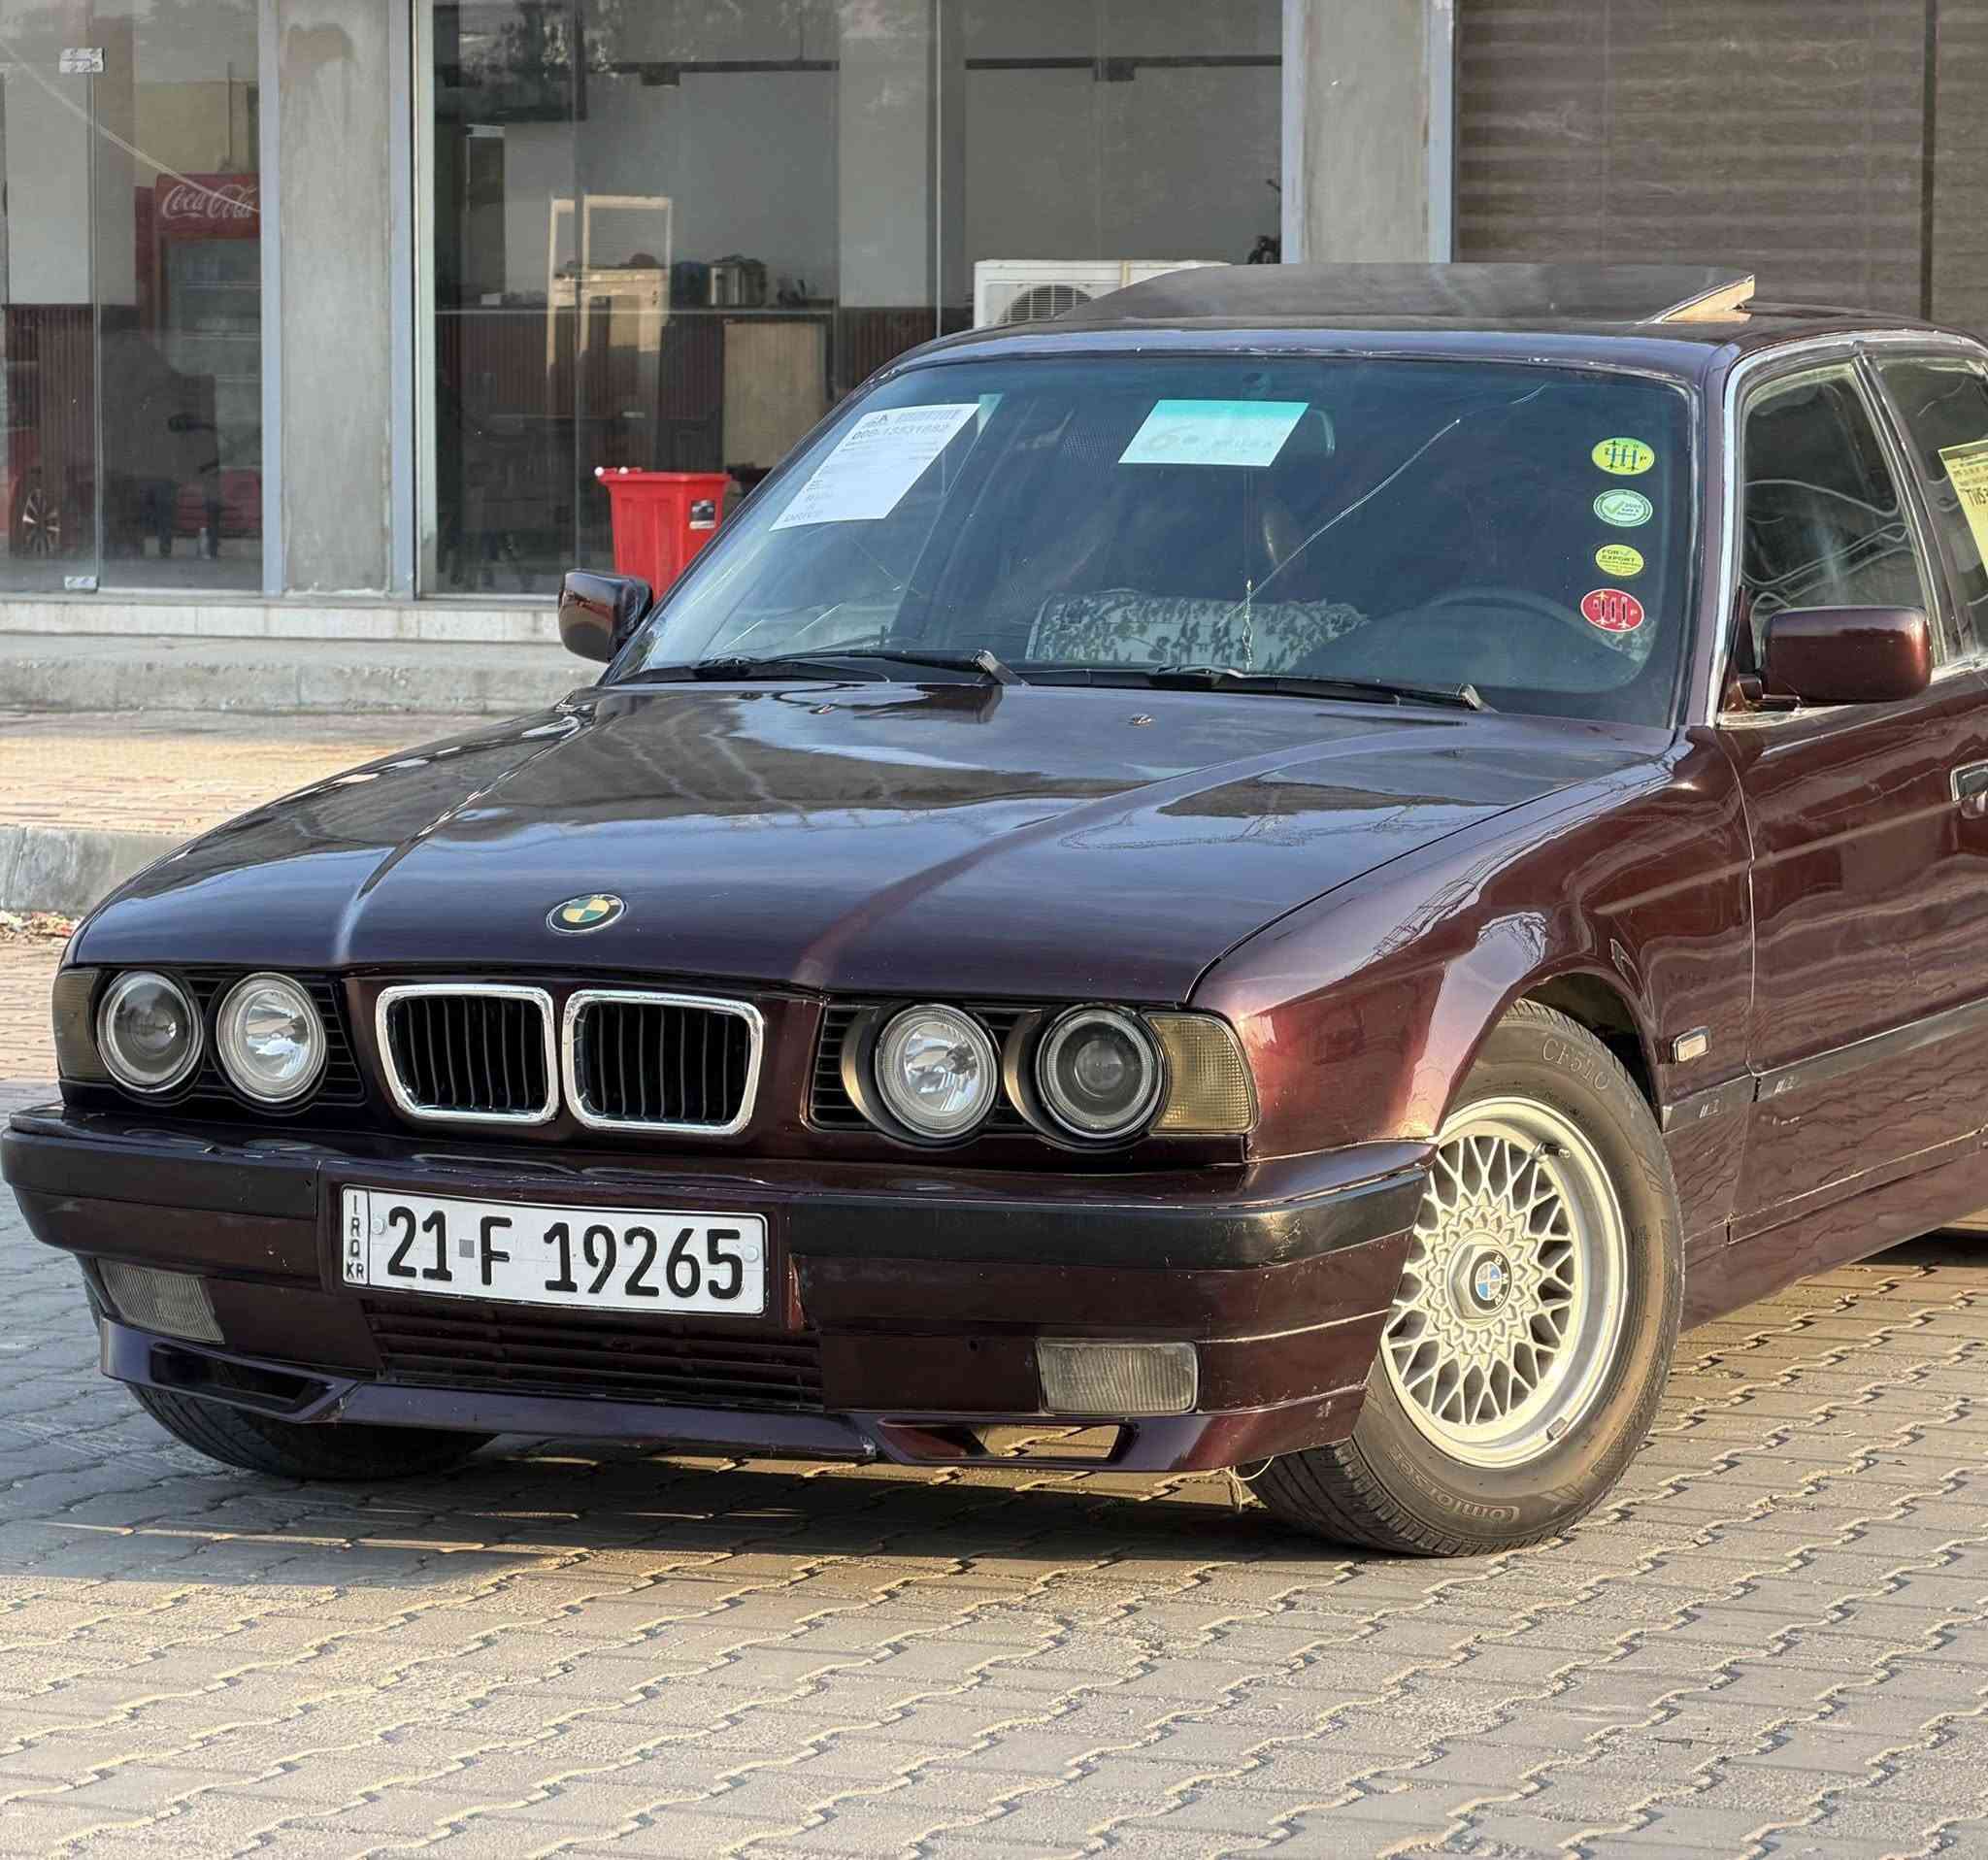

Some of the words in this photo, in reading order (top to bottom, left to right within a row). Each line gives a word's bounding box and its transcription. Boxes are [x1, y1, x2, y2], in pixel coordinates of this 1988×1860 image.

[347, 1262, 365, 1279] KR
[387, 1206, 453, 1282] 21
[480, 1215, 514, 1286] F
[543, 1221, 745, 1300] 19265
